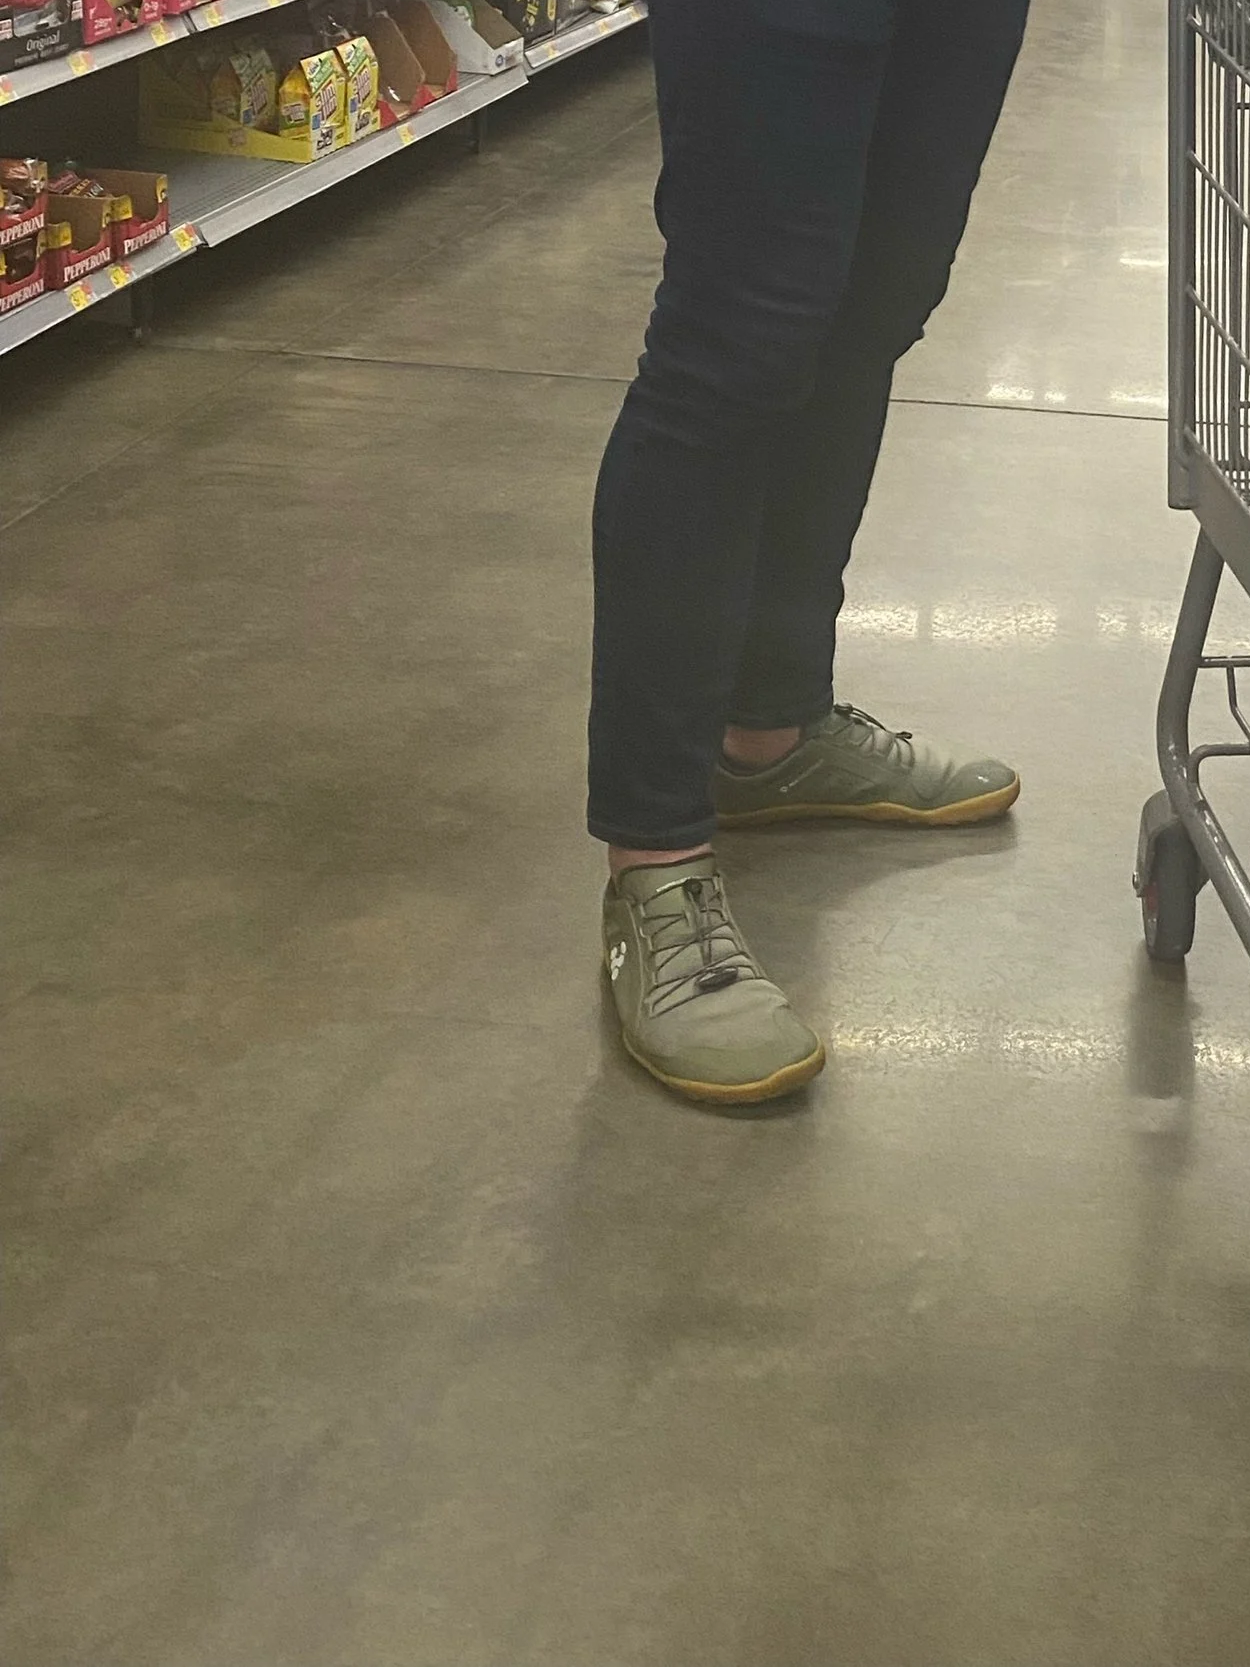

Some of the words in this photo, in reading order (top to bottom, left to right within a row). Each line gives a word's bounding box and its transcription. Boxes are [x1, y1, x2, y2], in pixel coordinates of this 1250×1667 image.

[27, 29, 60, 53] Original
[124, 221, 168, 255] PEPPERONI
[63, 246, 111, 283] PEPPERONI
